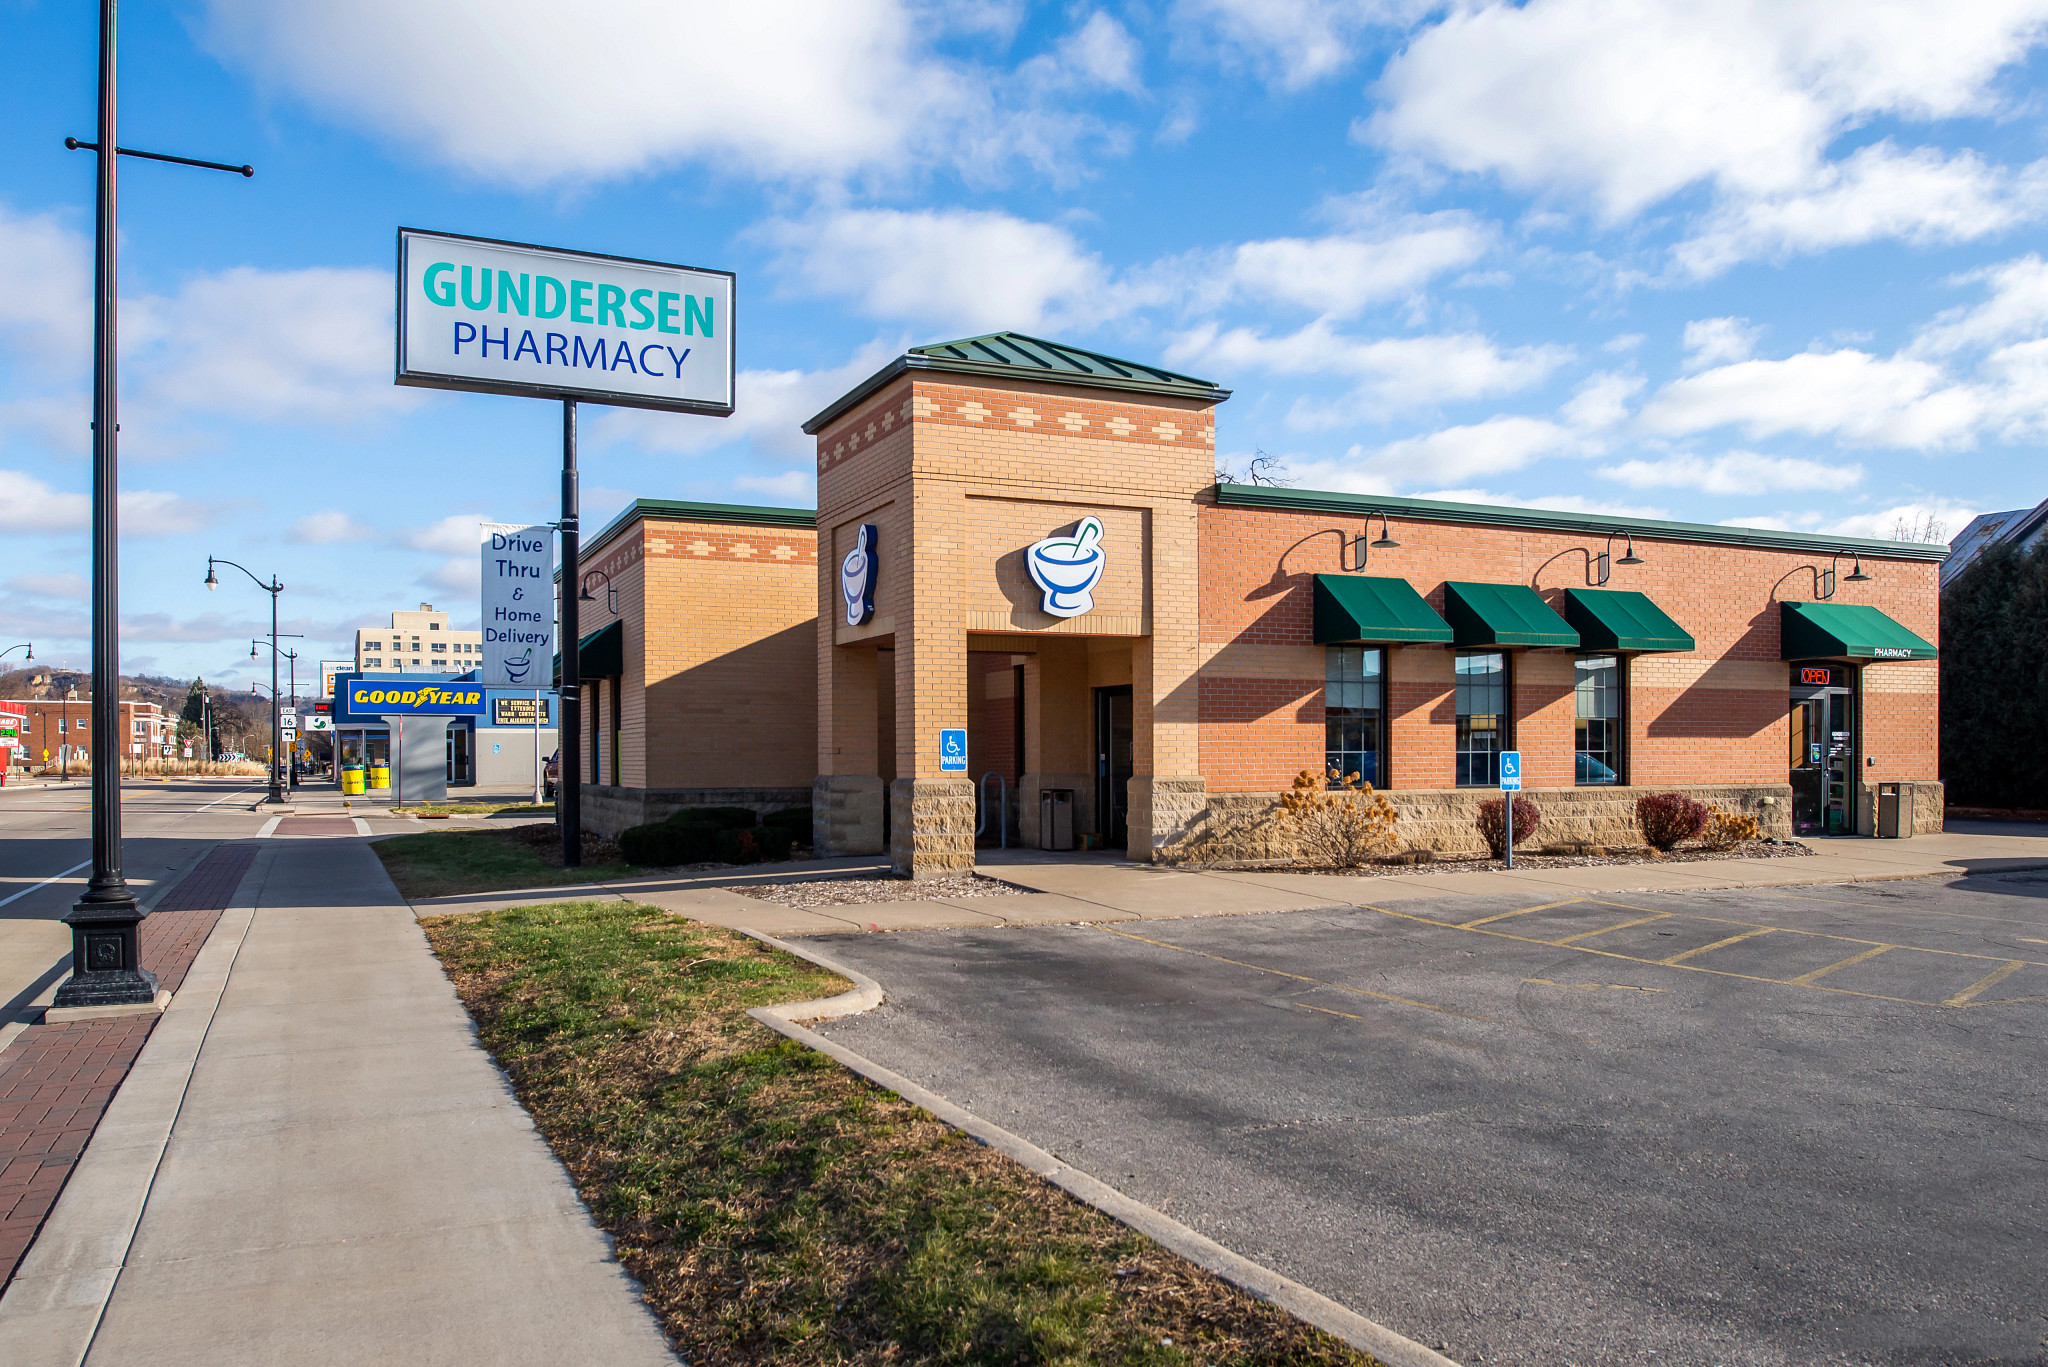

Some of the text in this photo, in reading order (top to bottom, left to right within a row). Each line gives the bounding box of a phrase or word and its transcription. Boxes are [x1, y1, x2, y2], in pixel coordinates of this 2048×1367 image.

[422, 261, 714, 338] GUNDERSEN
[454, 321, 691, 379] PHARMACY
[492, 532, 543, 552] Drive
[495, 559, 540, 578] Thru
[512, 587, 524, 601] &
[495, 607, 542, 622] Home
[486, 627, 549, 646] Delivery
[1874, 647, 1912, 658] PHARMACY
[1802, 669, 1829, 684] OPEN
[283, 717, 293, 726] 16
[942, 755, 966, 765] PARKING
[1501, 776, 1520, 785] PARKING
